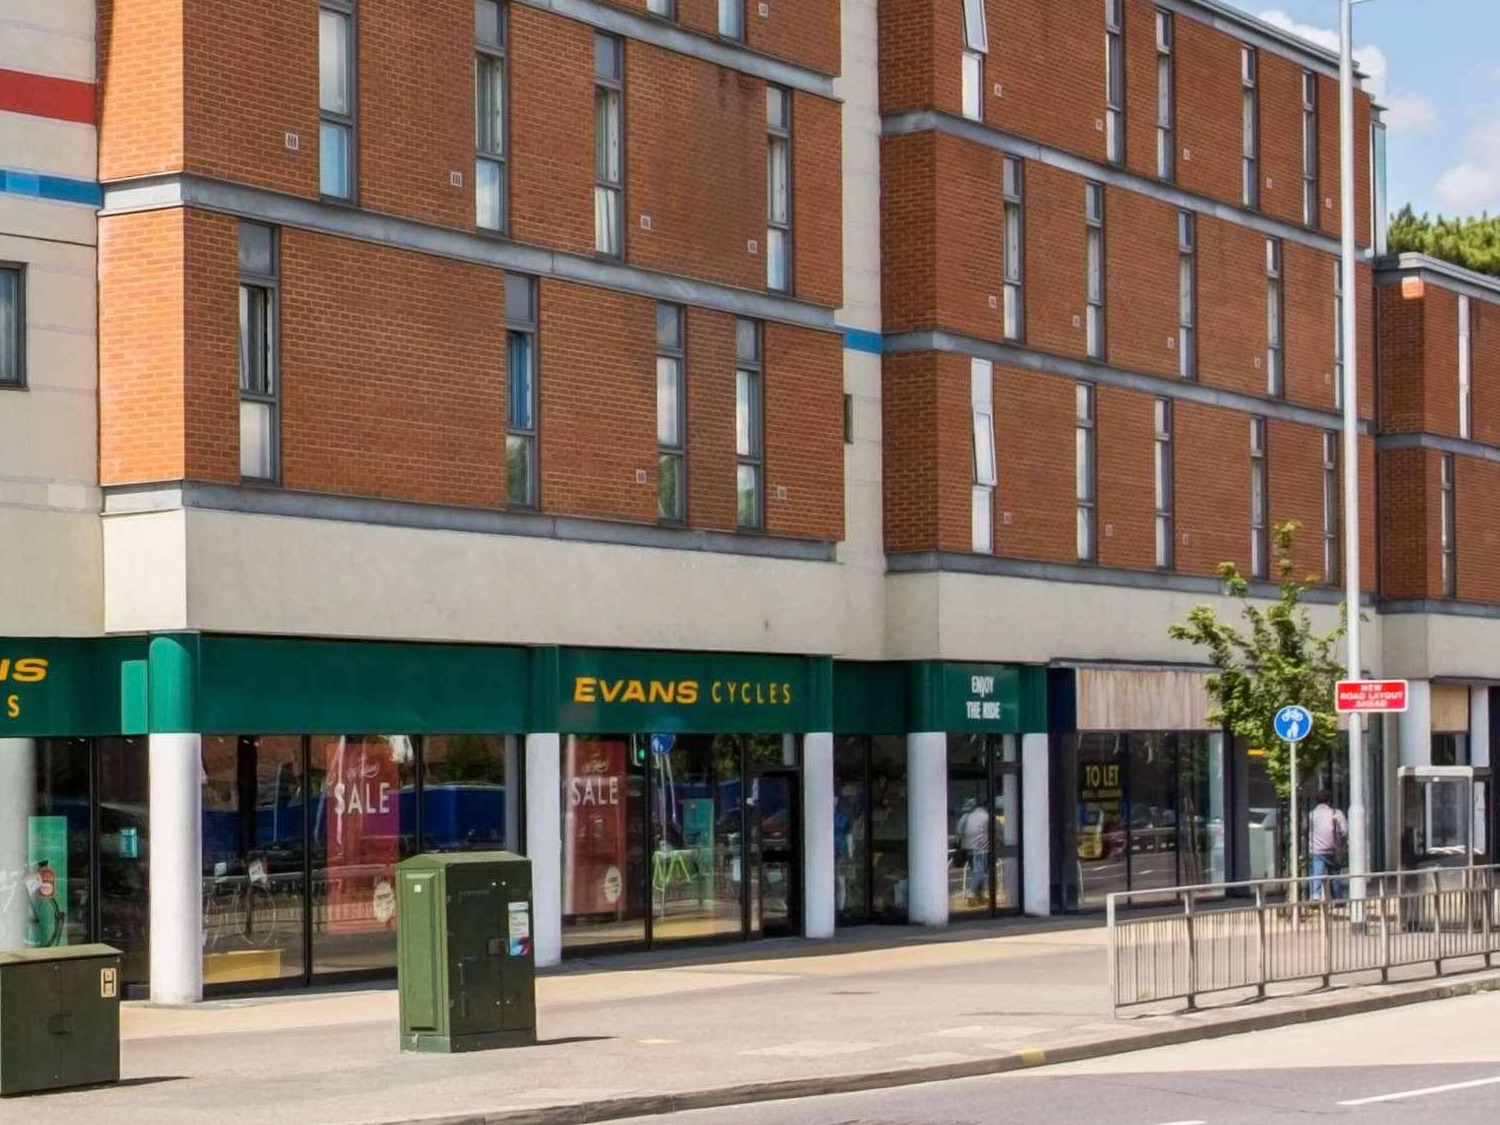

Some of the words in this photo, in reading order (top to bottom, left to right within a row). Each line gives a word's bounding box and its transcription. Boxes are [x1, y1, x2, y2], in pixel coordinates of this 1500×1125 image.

[573, 677, 700, 704] EVANS
[711, 681, 792, 705] CYCLES
[971, 675, 995, 698] ENJOY
[1340, 692, 1366, 700] ROAD
[1368, 691, 1403, 700] LAYOUT
[1360, 684, 1383, 692] NEW
[966, 701, 981, 719] THE
[982, 702, 1000, 719] RIDE
[1085, 765, 1100, 787] TO
[1103, 765, 1119, 786] LET
[334, 782, 390, 814] SALE
[571, 776, 619, 806] SALE
